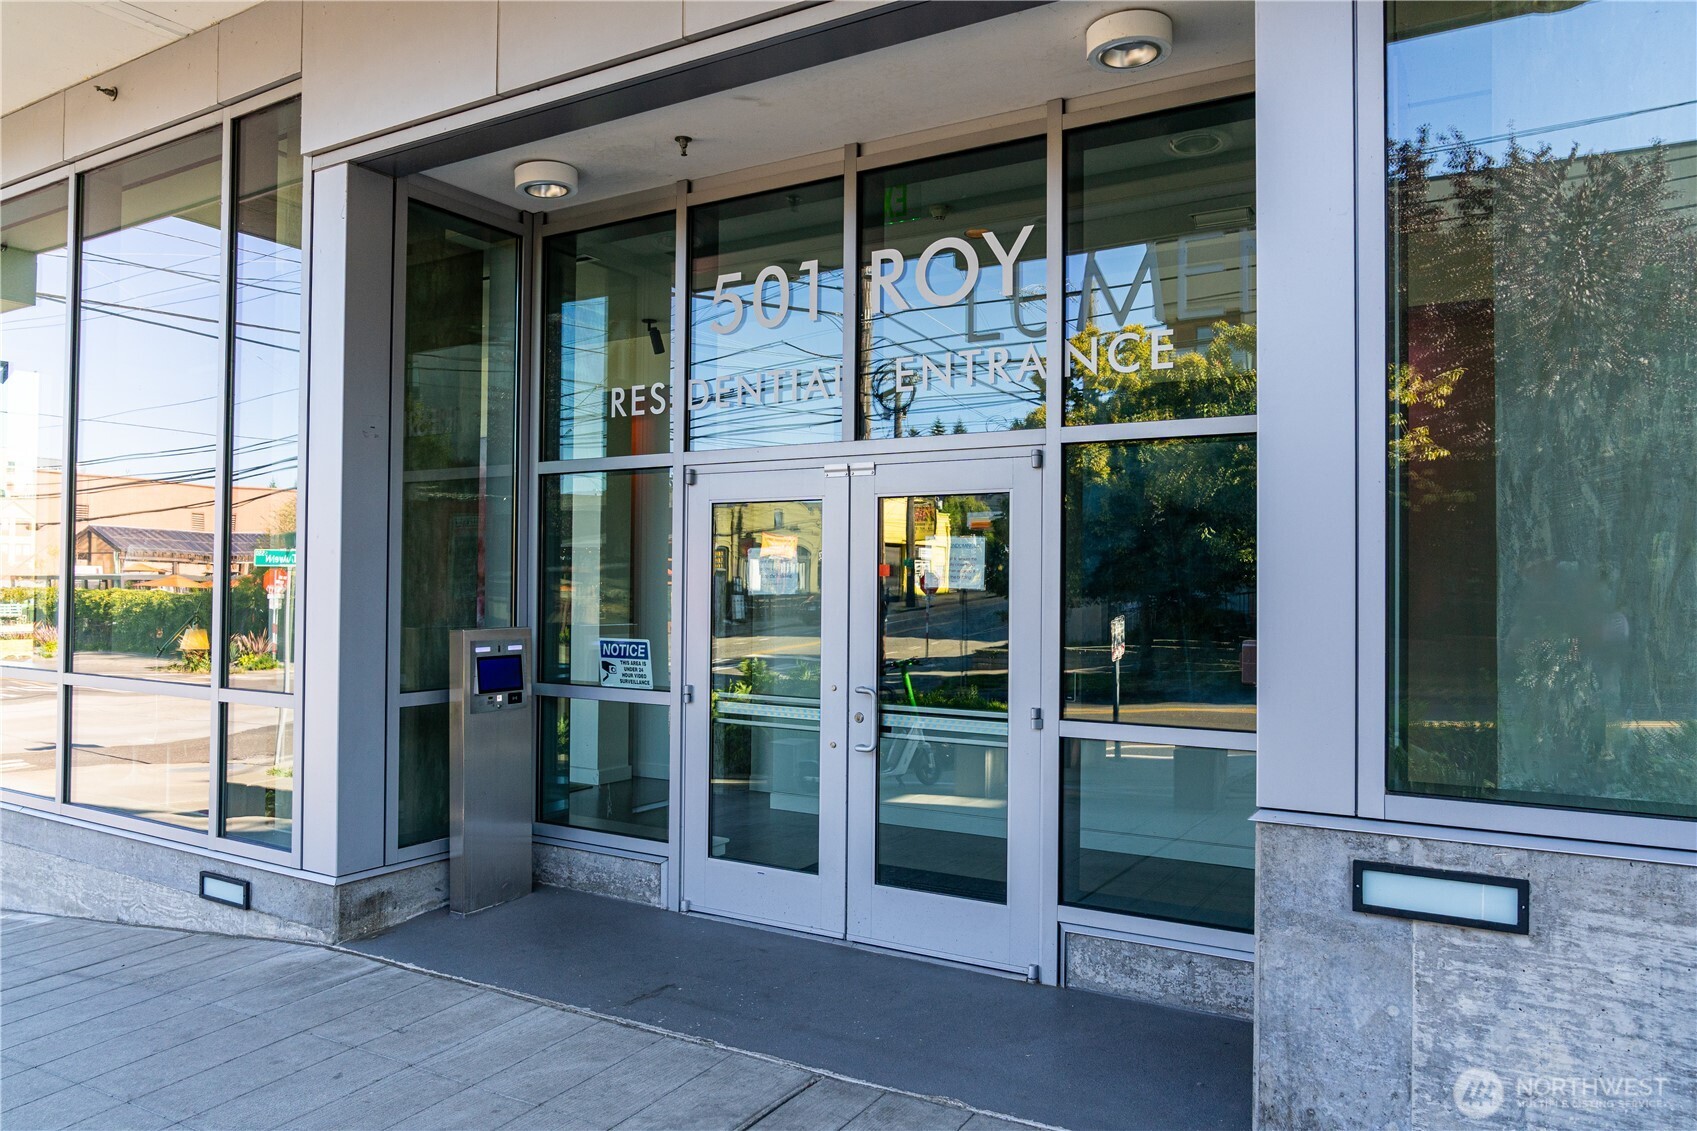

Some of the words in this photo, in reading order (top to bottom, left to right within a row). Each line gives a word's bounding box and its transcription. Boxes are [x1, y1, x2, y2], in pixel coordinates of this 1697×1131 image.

[710, 259, 821, 335] 501
[870, 224, 1035, 314] ROY
[966, 228, 1252, 343] LUME
[610, 365, 843, 418] RESDENTIAL
[895, 329, 1174, 393] ENTRANCE
[602, 643, 646, 657] NOTICE
